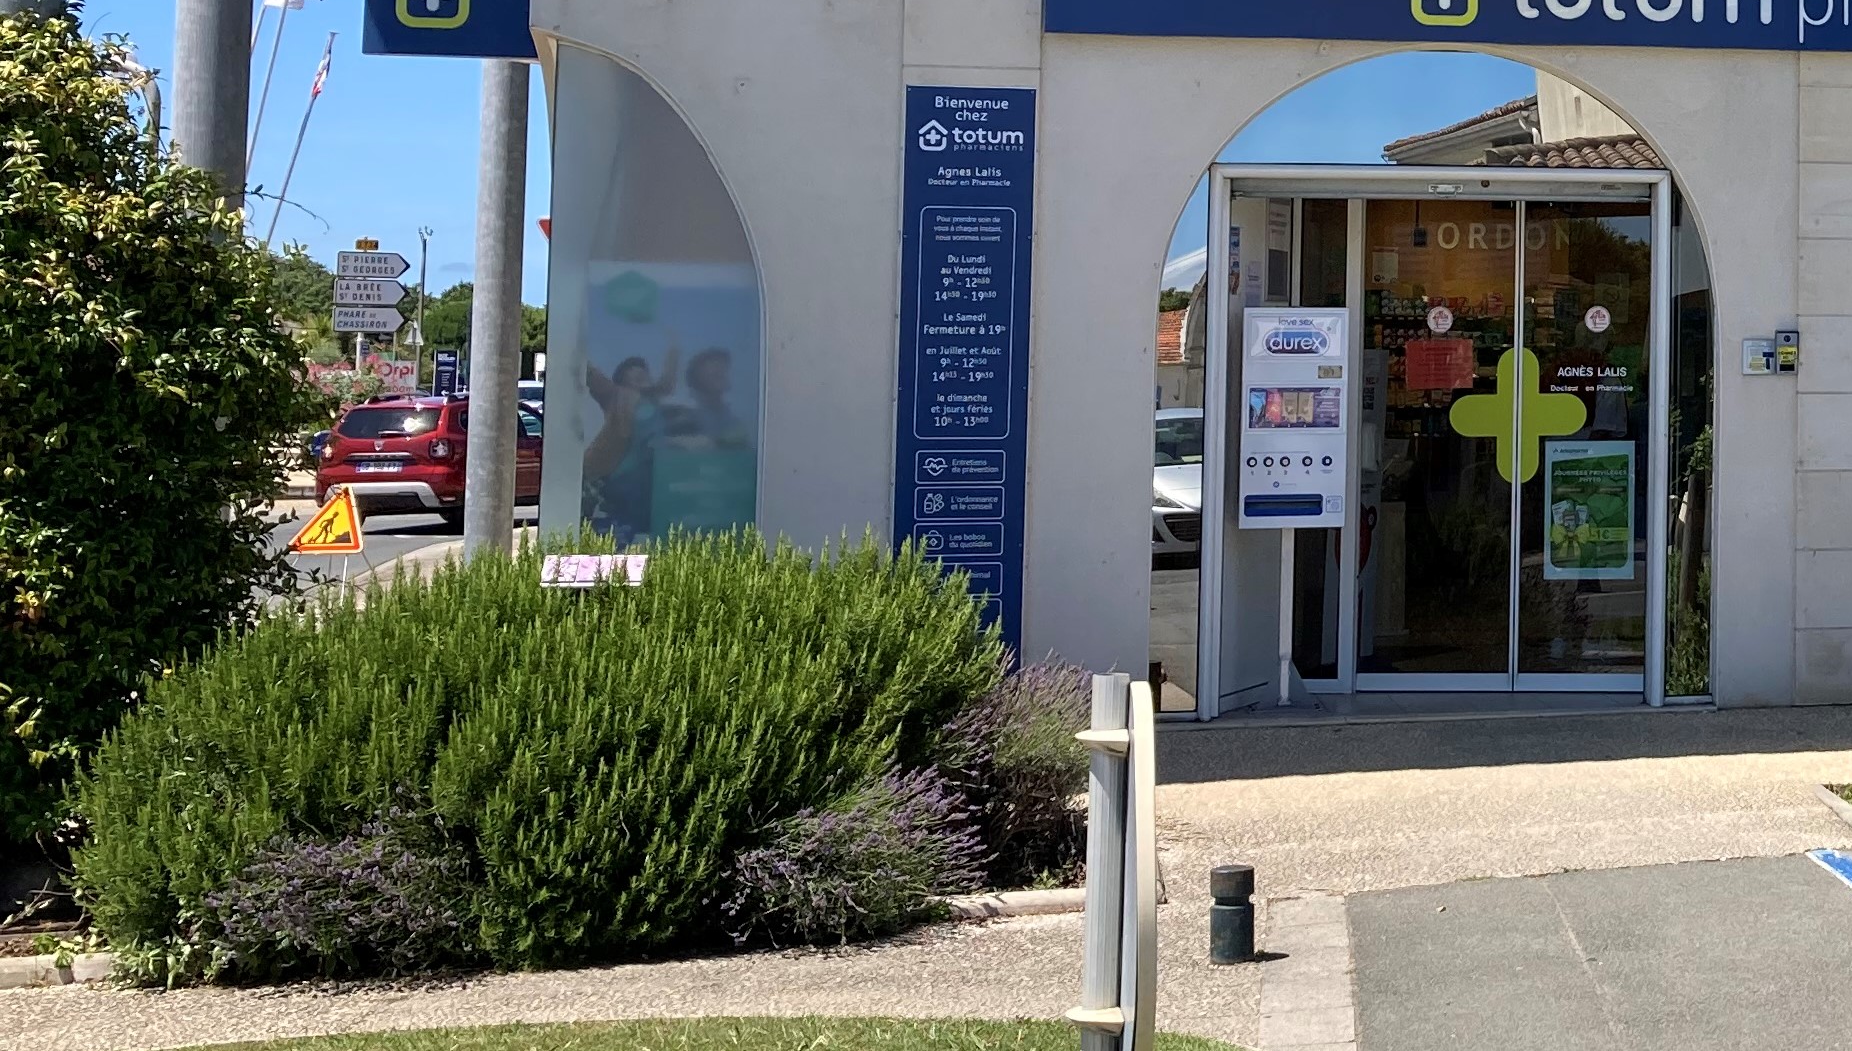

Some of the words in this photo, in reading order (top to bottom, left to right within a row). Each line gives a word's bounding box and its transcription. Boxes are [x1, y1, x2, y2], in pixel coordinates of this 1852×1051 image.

[935, 96, 1009, 109] Bienvenue
[955, 109, 988, 121] chez
[951, 127, 1024, 144] totum
[953, 143, 1024, 152] pharmaciens
[975, 167, 1002, 176] Lalis
[972, 178, 1011, 186] Pharmacie
[354, 256, 389, 264] PIERRE
[947, 254, 959, 263] Du
[961, 254, 986, 263] Lundi
[353, 266, 395, 274] GEORGES
[954, 266, 992, 274] Vendredi
[352, 293, 382, 301] DENIS
[338, 310, 366, 318] PHARE
[943, 313, 954, 321] Le
[956, 313, 987, 321] Samedi
[336, 320, 387, 328] CHASSIRON
[1278, 317, 1297, 325] love
[923, 324, 976, 334] Fermeture
[979, 325, 985, 334] à
[1269, 333, 1323, 350] durex
[940, 346, 967, 354] Juillet
[377, 362, 415, 379] Orpi
[1557, 365, 1594, 376] AGNÈS
[1597, 367, 1628, 376] LALIS
[947, 393, 988, 402] dimanche
[930, 405, 940, 413] et
[943, 405, 965, 415] jours
